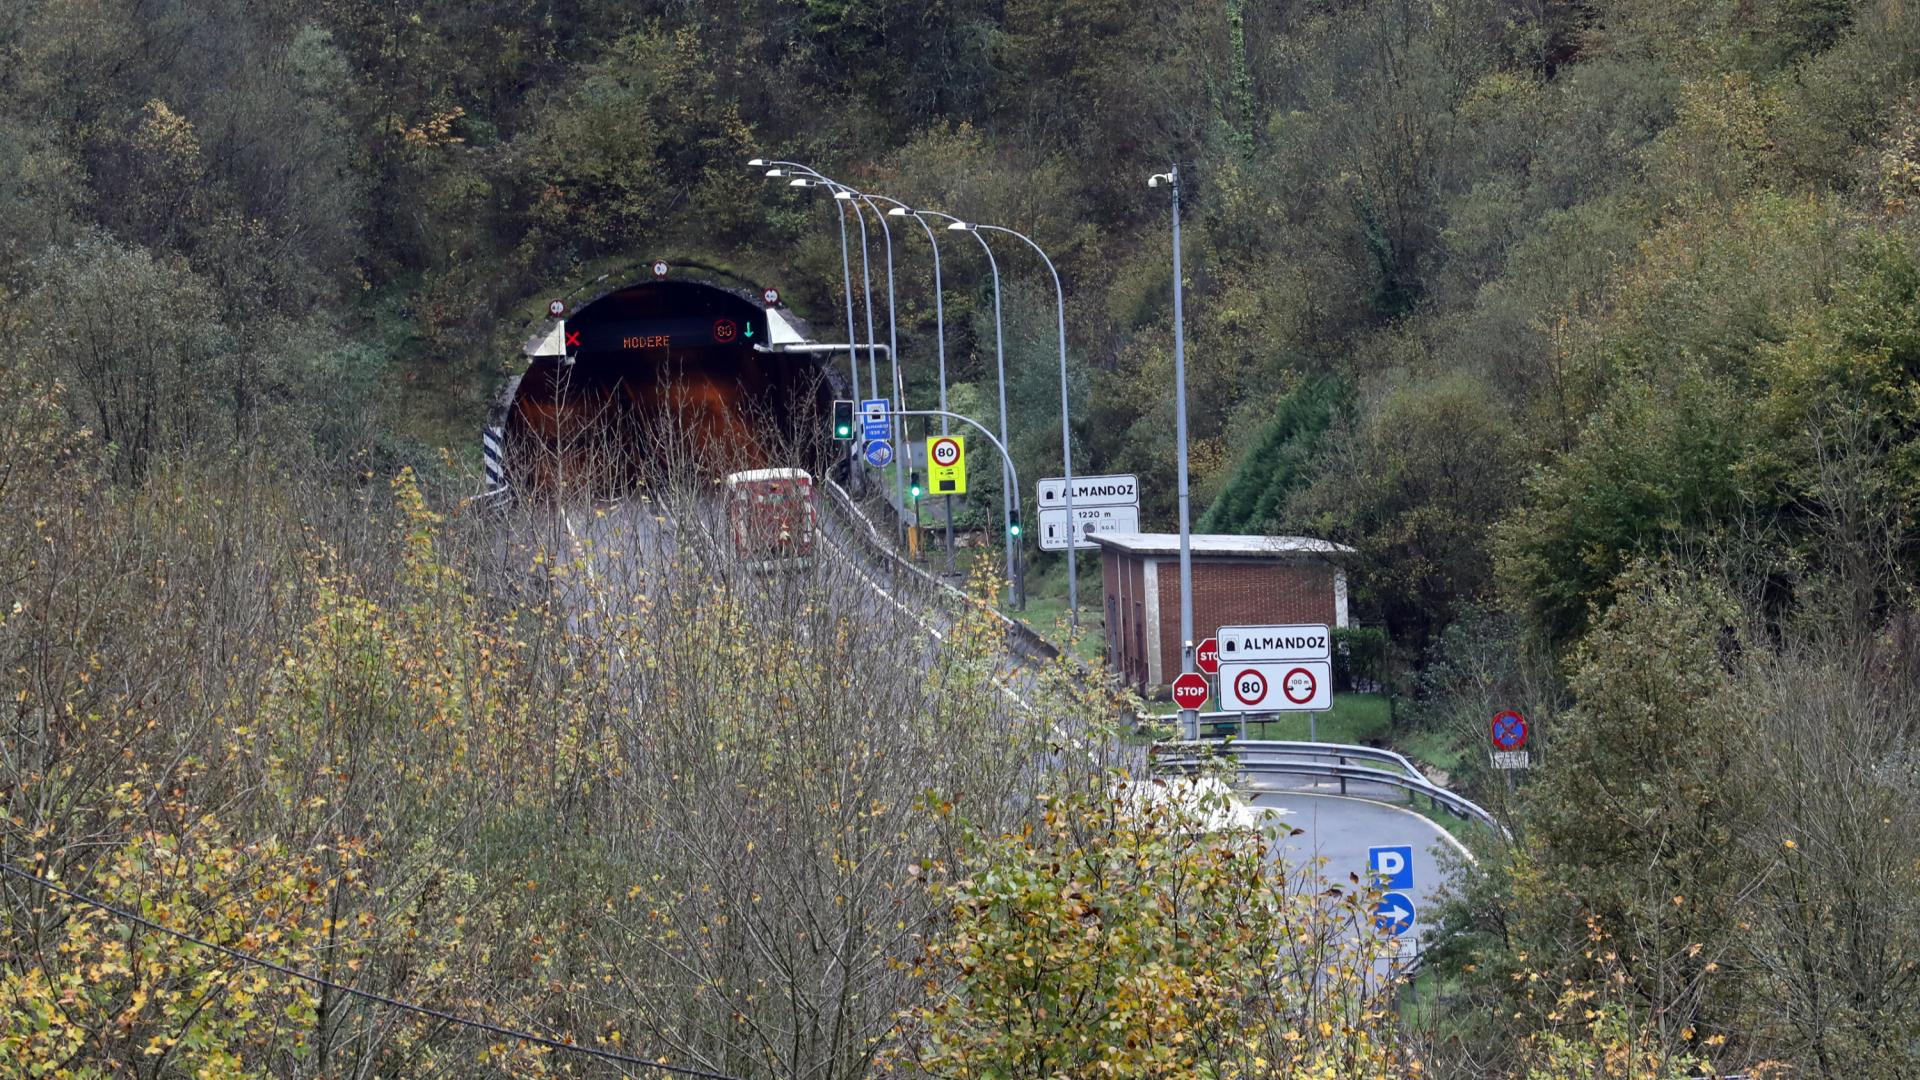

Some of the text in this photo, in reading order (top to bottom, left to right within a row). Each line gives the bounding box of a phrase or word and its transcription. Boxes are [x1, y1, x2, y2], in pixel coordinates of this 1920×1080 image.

[937, 447, 954, 457] 80
[1078, 510, 1100, 519] 1220
[1244, 637, 1325, 649] ALMANDOZ
[1200, 652, 1217, 660] STO
[1177, 687, 1204, 696] STOP
[1242, 682, 1260, 693] 80
[1377, 851, 1405, 885] P
